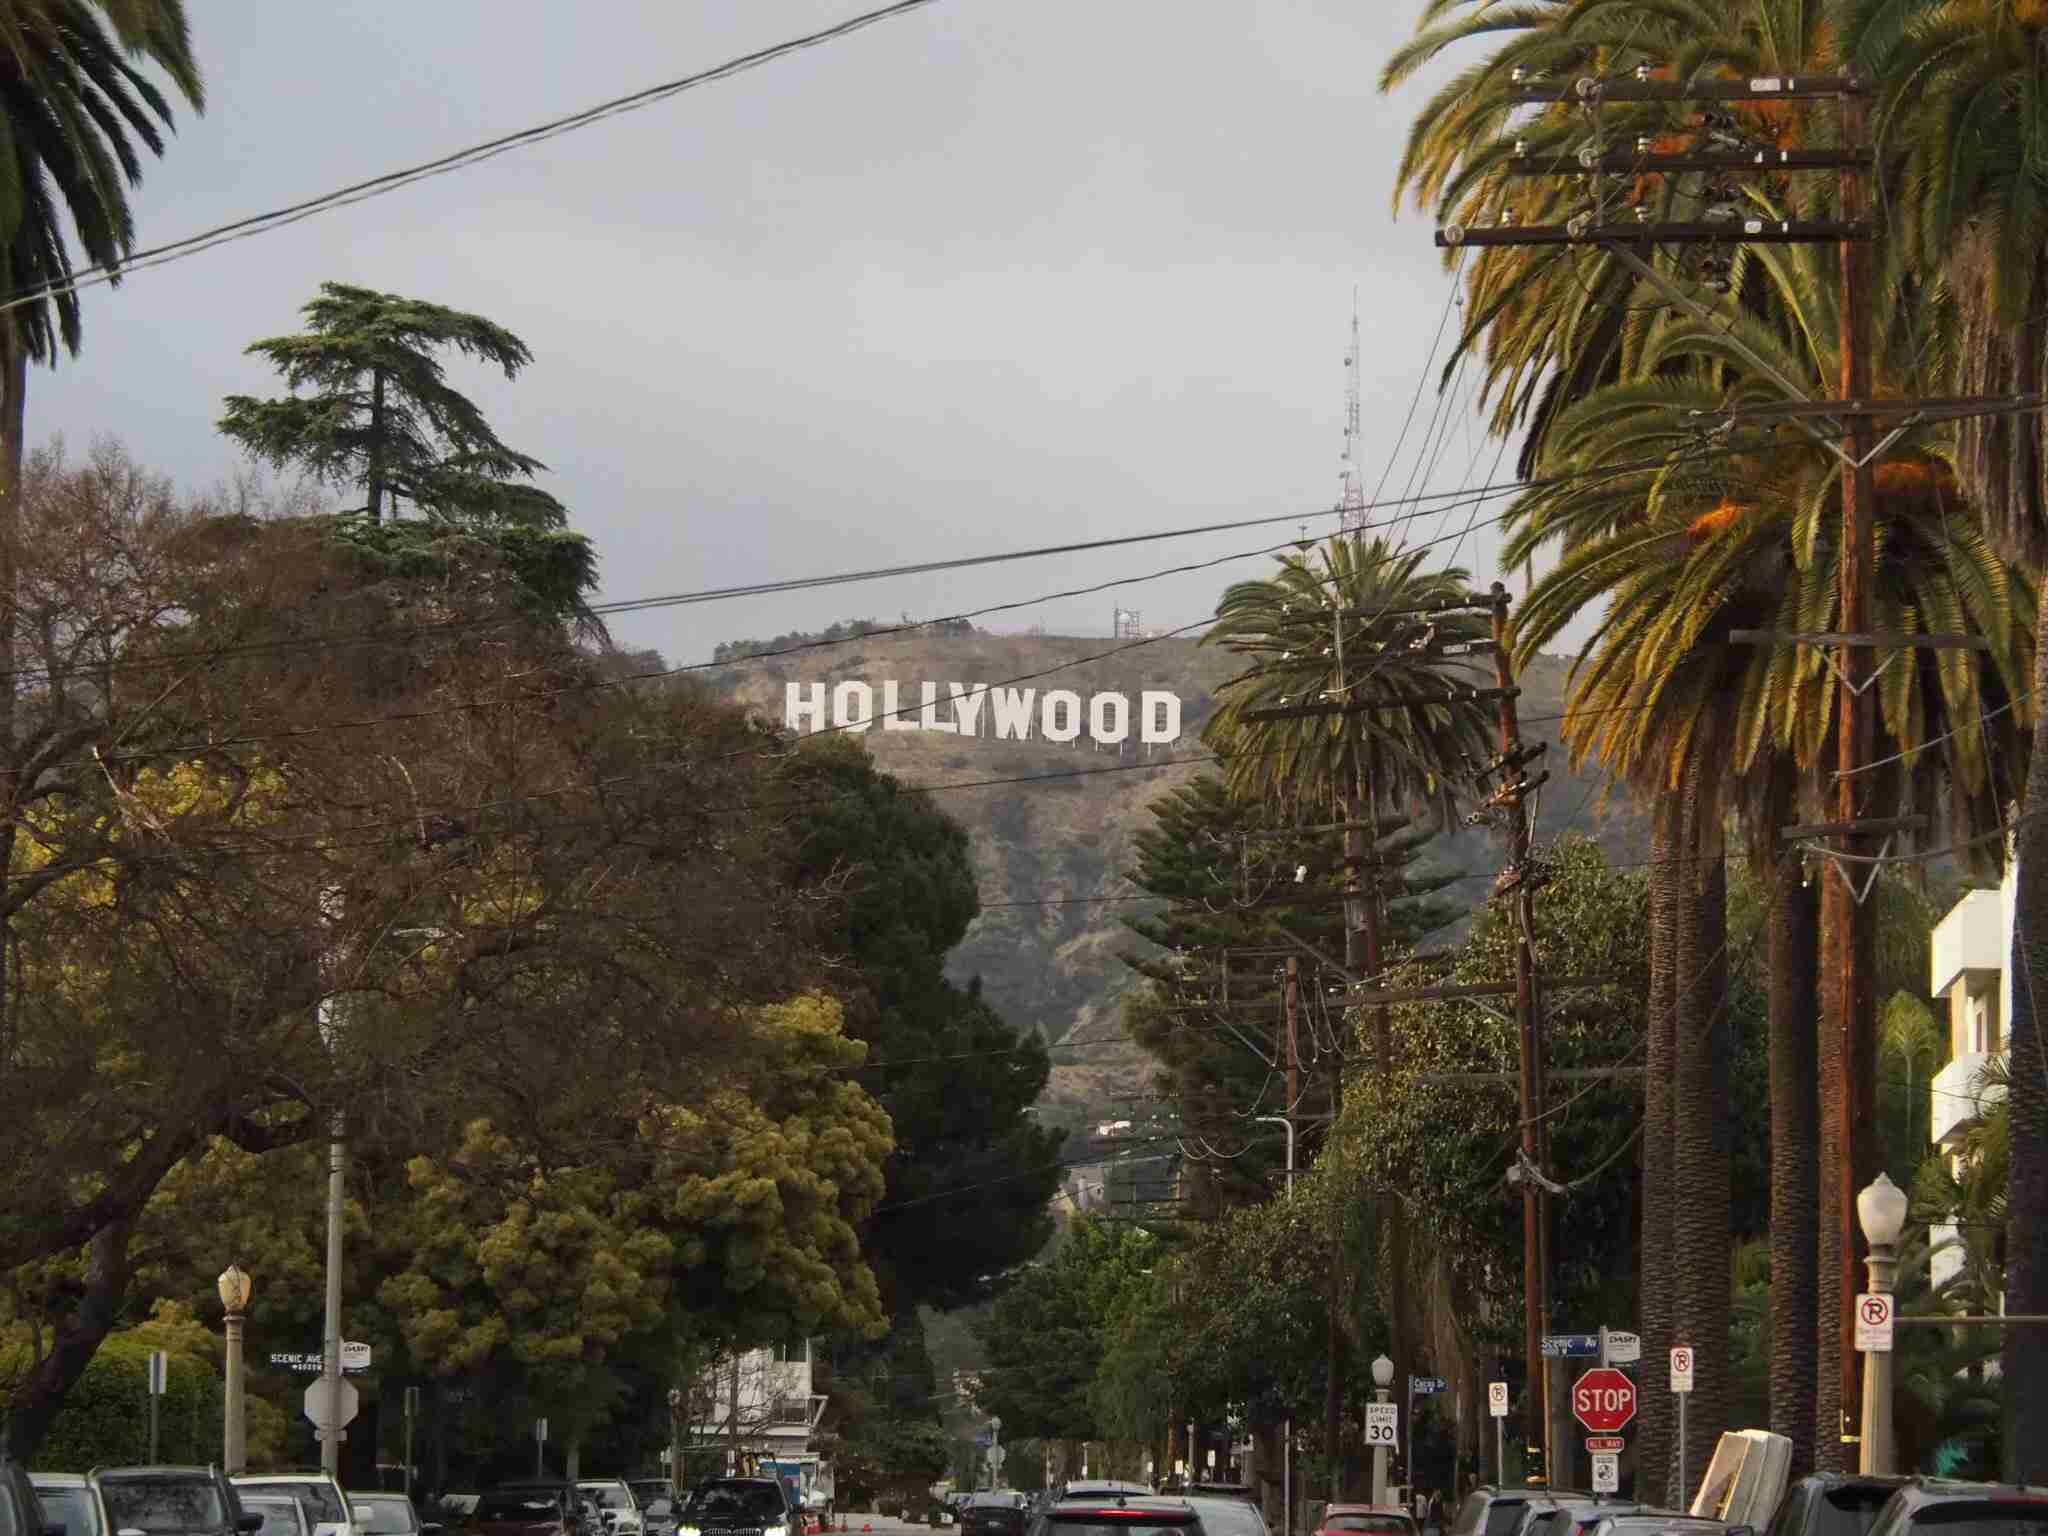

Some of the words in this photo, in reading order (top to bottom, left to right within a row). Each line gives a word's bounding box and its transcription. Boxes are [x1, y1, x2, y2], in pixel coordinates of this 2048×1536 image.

[785, 680, 1182, 746] HOLLYWOOD
[271, 1353, 303, 1363] SCENIC
[1577, 1388, 1631, 1412] STOP
[1370, 1415, 1393, 1424] LIMIT
[1370, 1425, 1393, 1440] 30
